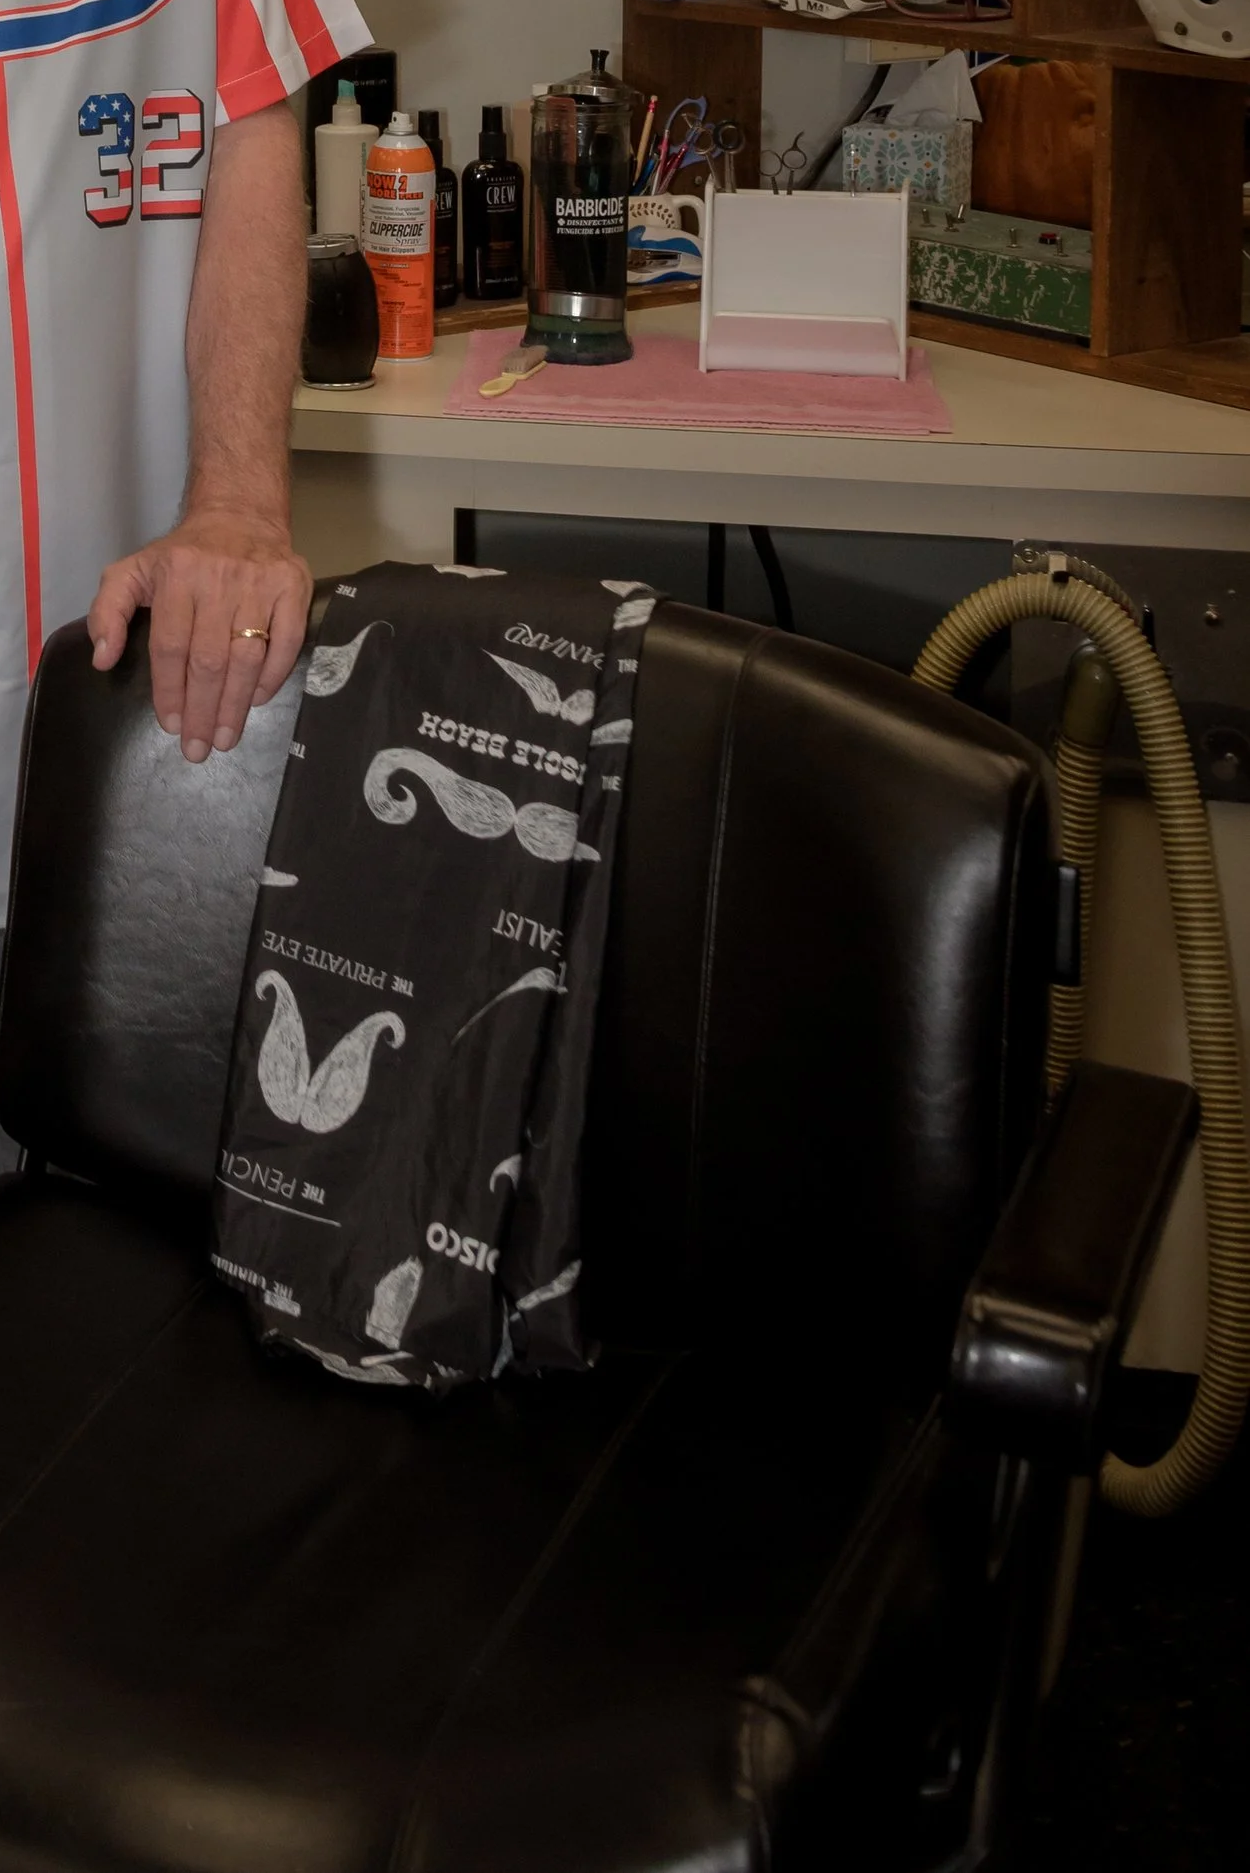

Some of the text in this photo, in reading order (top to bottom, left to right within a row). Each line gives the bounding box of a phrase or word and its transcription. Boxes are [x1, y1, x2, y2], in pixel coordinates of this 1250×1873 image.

[78, 88, 206, 230] 32
[367, 171, 396, 189] NOW
[369, 188, 397, 200] MORE
[486, 184, 516, 205] CREW
[556, 196, 626, 217] BARBICIDE
[369, 222, 424, 237] CLIPPERCIDE
[566, 218, 619, 226] DISINFECTANT
[556, 227, 594, 235] FUNGICIDE
[394, 236, 421, 246] Spray
[335, 584, 358, 598] THE
[618, 657, 639, 674] THE
[417, 711, 508, 759] BEACH
[262, 930, 415, 997] THE PRIVATE EYE
[301, 1181, 326, 1205] THE
